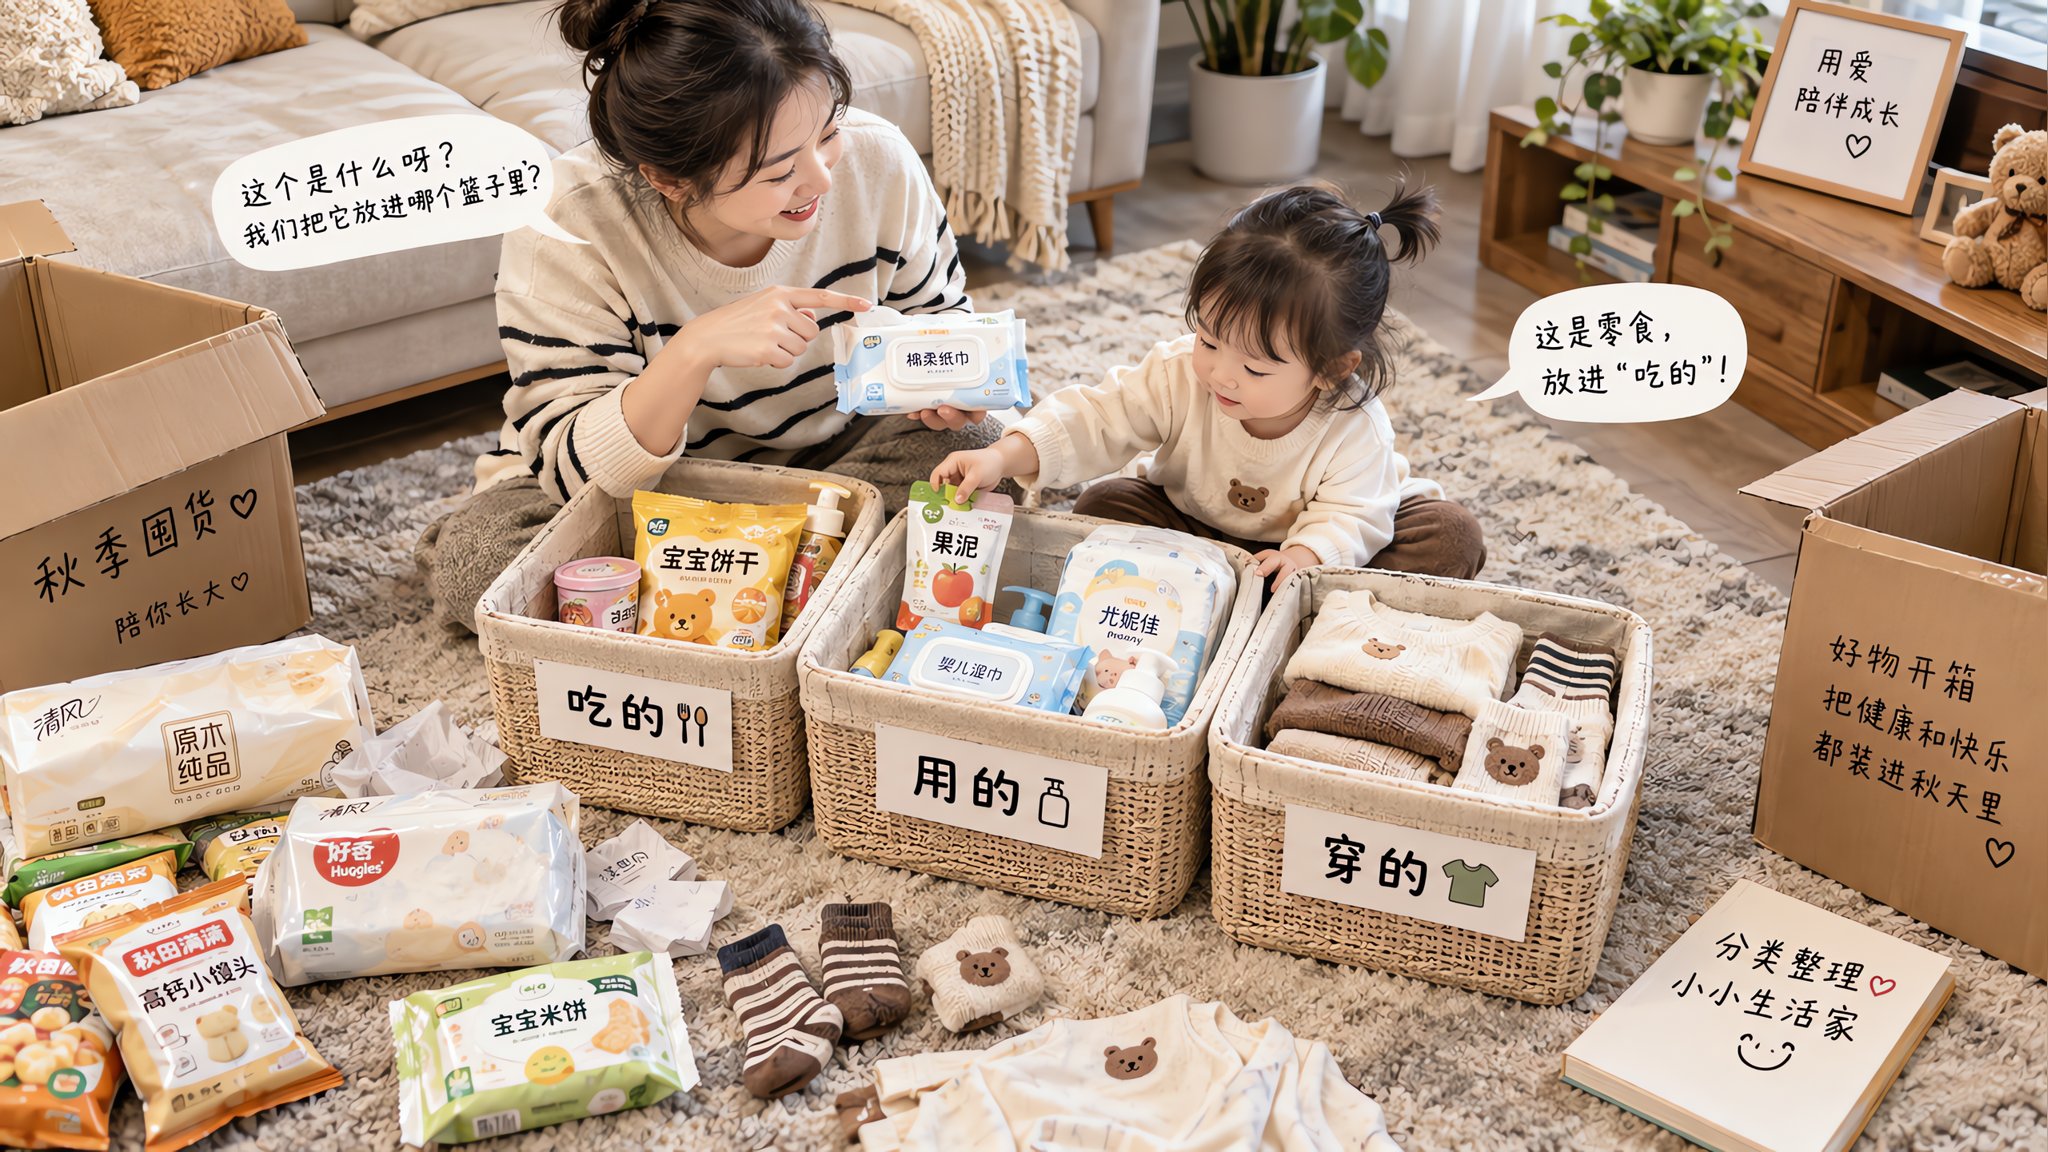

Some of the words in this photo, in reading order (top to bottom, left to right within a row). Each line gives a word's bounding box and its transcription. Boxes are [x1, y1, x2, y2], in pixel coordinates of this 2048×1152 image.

[1817, 48, 1873, 84] 用爱
[1794, 86, 1899, 128] 陪伴成长
[906, 350, 969, 367] 棉柔纸巾
[33, 489, 217, 603] 秋季囤货
[659, 545, 759, 576] 宝宝饼干
[931, 530, 979, 559] 果泥
[114, 580, 225, 645] 陪你长大
[1098, 605, 1160, 636] 尤妮佳
[1829, 634, 1976, 703] 好物开箱
[33, 696, 100, 742] 清风
[567, 685, 664, 738] 吃的
[1822, 684, 2009, 773] 把健康和快乐
[173, 722, 227, 756] 原木
[177, 751, 231, 785] 纯品
[913, 755, 1020, 818] 用的
[1812, 730, 2003, 826] 都装进秋天里
[1323, 832, 1428, 898] 穿的
[1715, 932, 1865, 992] 分类整理
[491, 998, 588, 1038] 宝宝米饼
[1671, 972, 1859, 1042] 小小生活家
